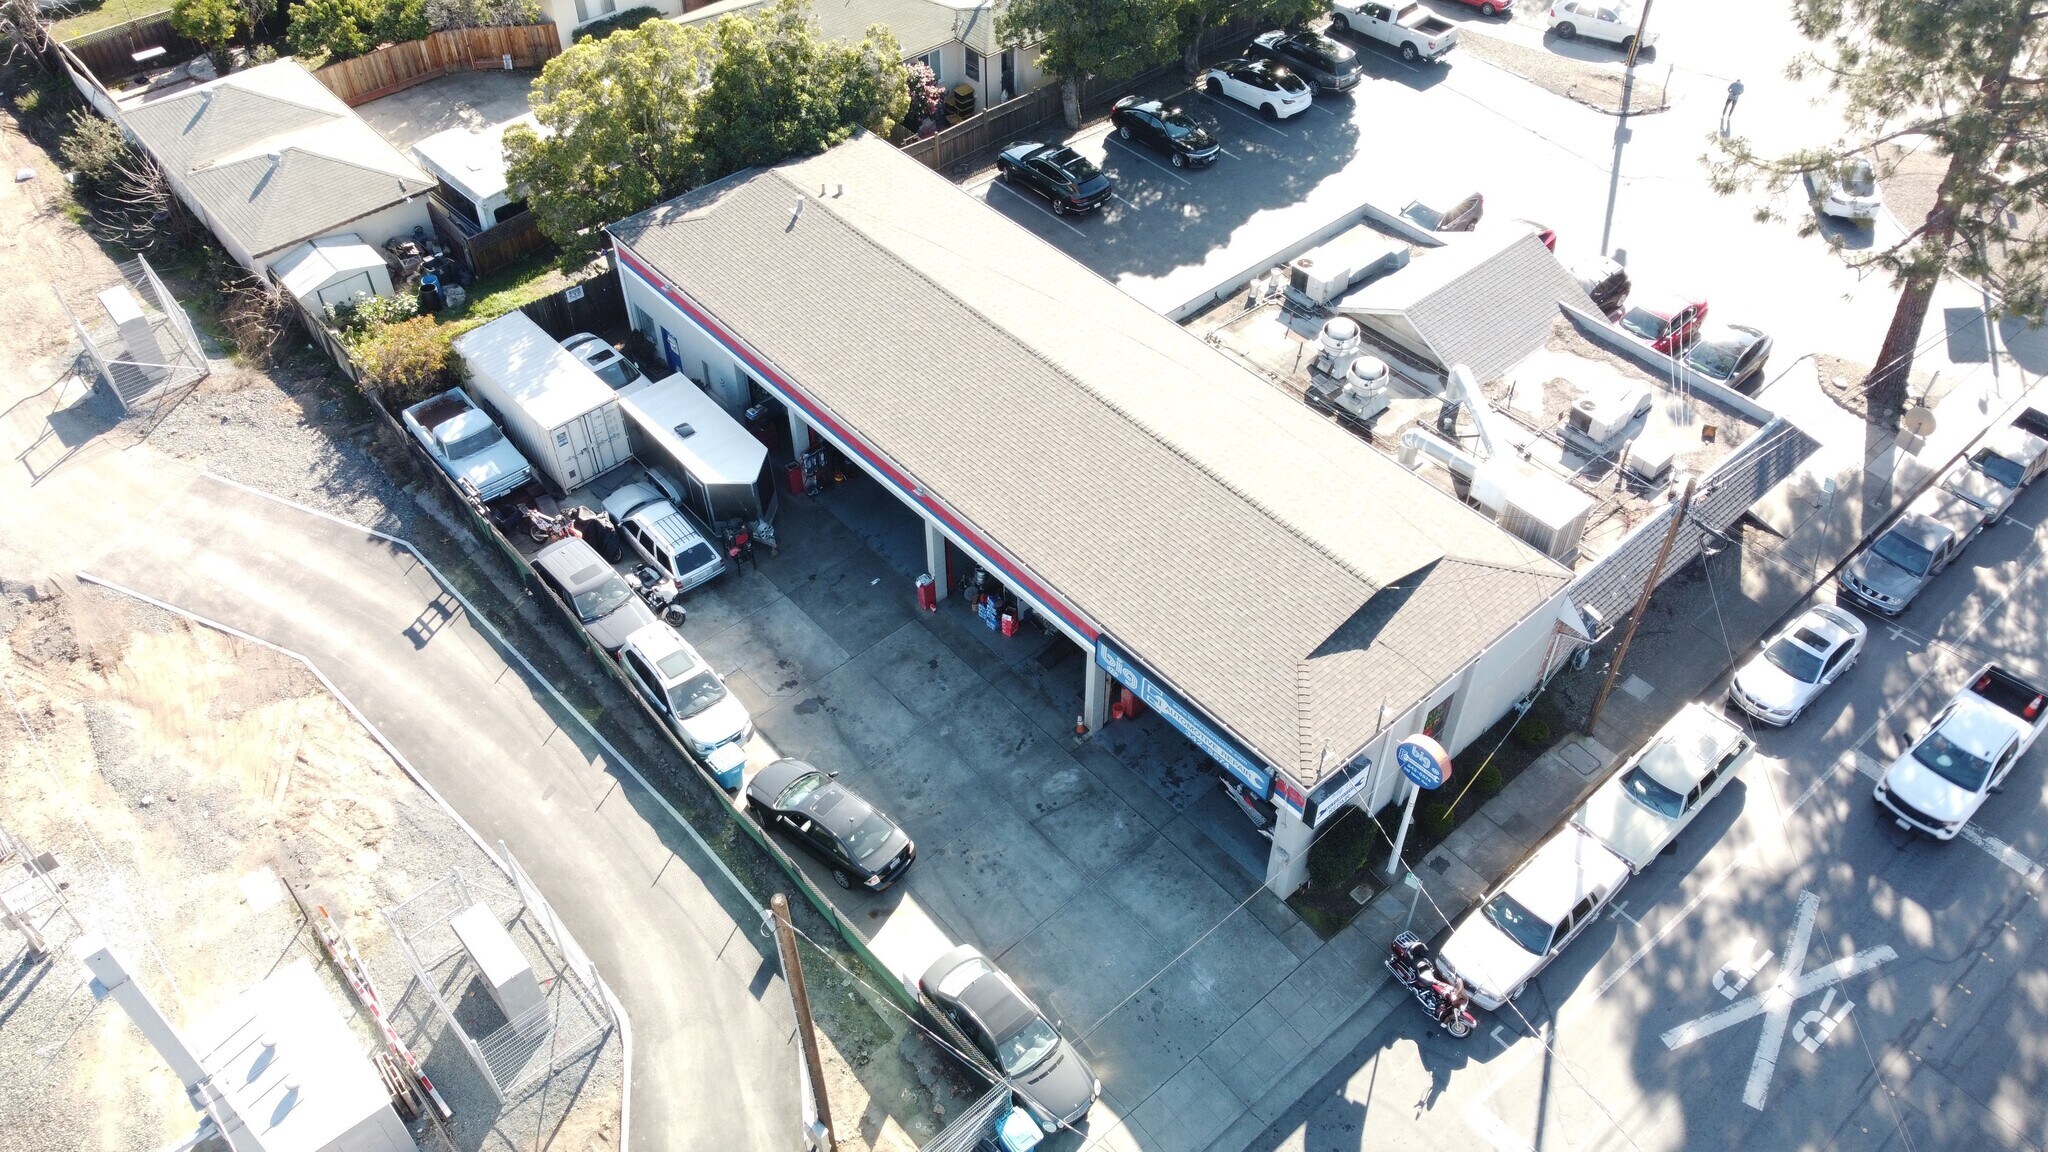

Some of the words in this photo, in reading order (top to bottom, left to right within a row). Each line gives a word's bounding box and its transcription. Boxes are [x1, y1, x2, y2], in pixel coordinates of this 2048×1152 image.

[1101, 643, 1138, 690] big
[1165, 706, 1219, 752] AUTOMOTIVE
[1220, 750, 1253, 780] REPAIR
[1184, 729, 1230, 769] 342-5574
[1411, 745, 1431, 768] big
